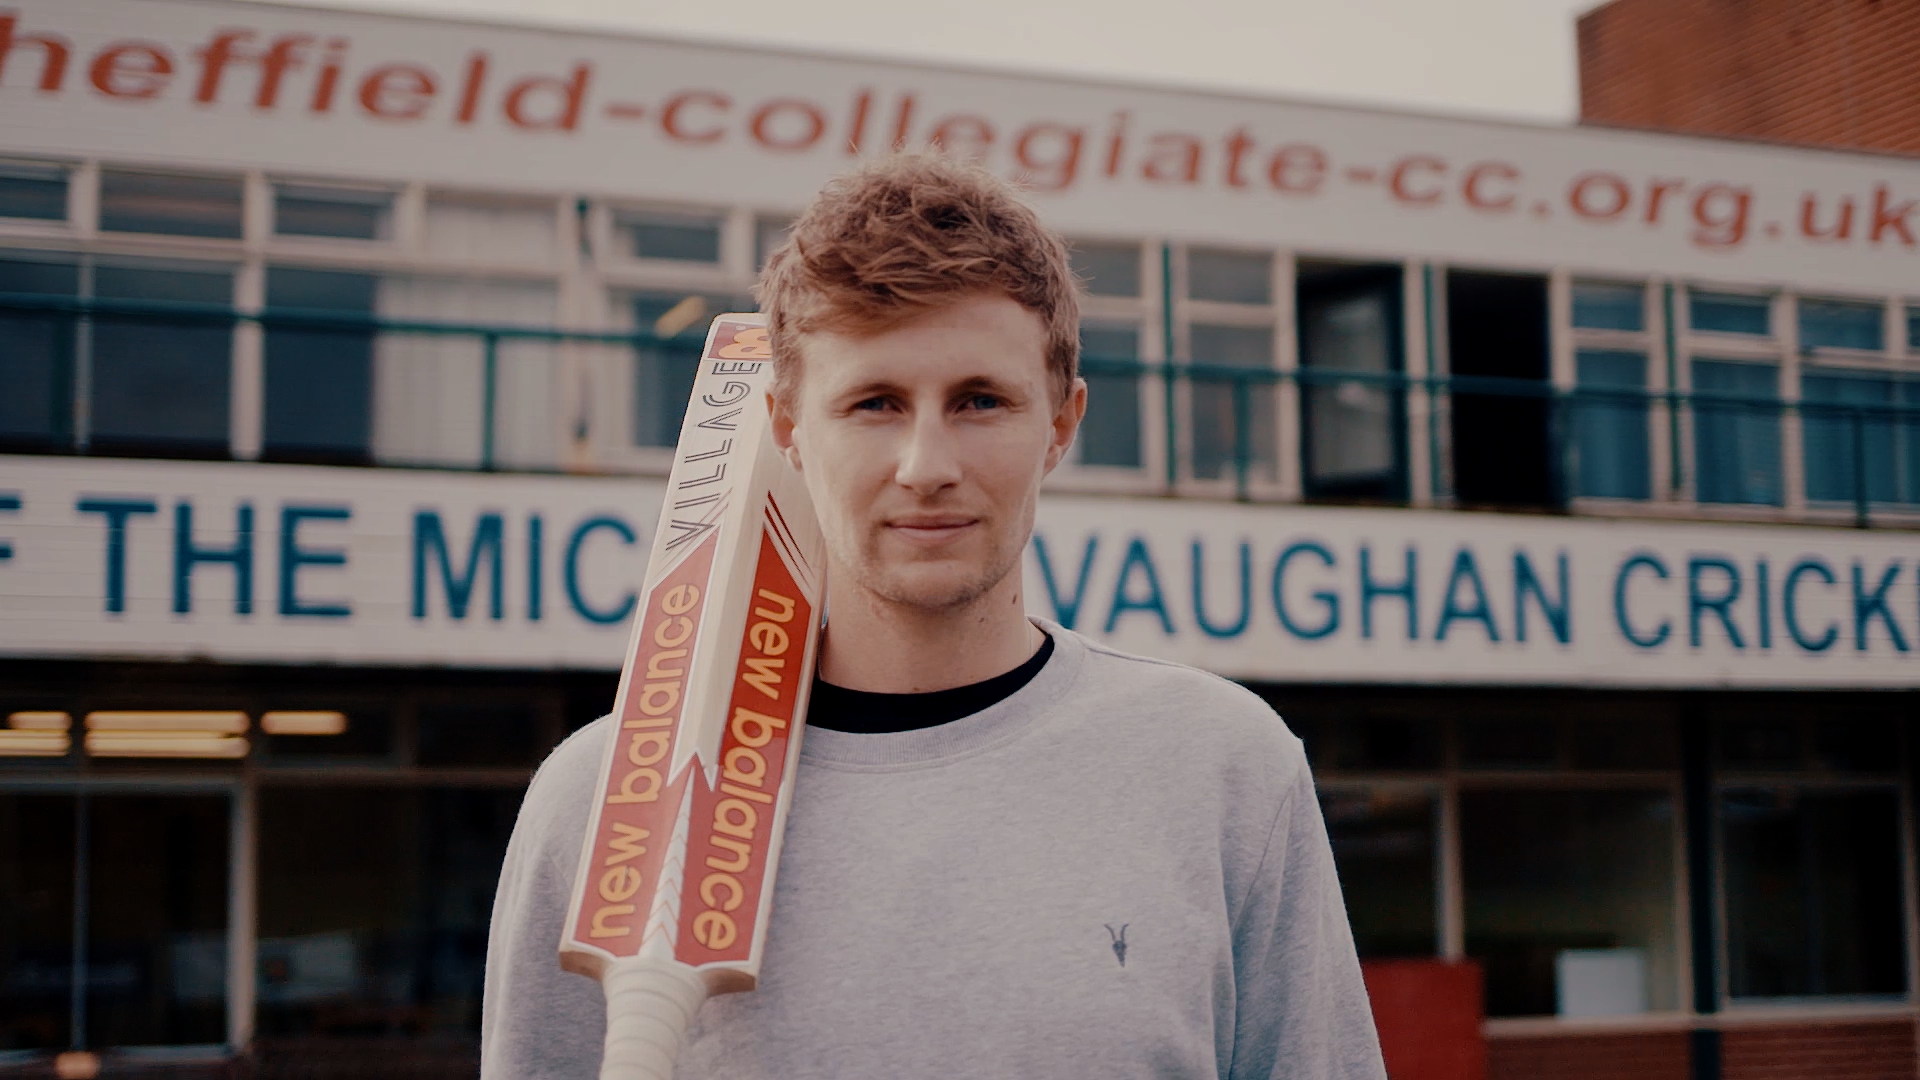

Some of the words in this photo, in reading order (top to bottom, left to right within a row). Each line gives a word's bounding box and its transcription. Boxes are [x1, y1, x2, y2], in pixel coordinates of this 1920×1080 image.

[665, 362, 762, 551] VILLAGE
[76, 497, 351, 616] THE
[1033, 534, 1571, 644] VAUGHAN
[1614, 552, 1920, 654] CRICK
[742, 588, 796, 700] new
[606, 583, 700, 804] balance
[590, 822, 651, 939] new
[692, 706, 787, 952] balance
